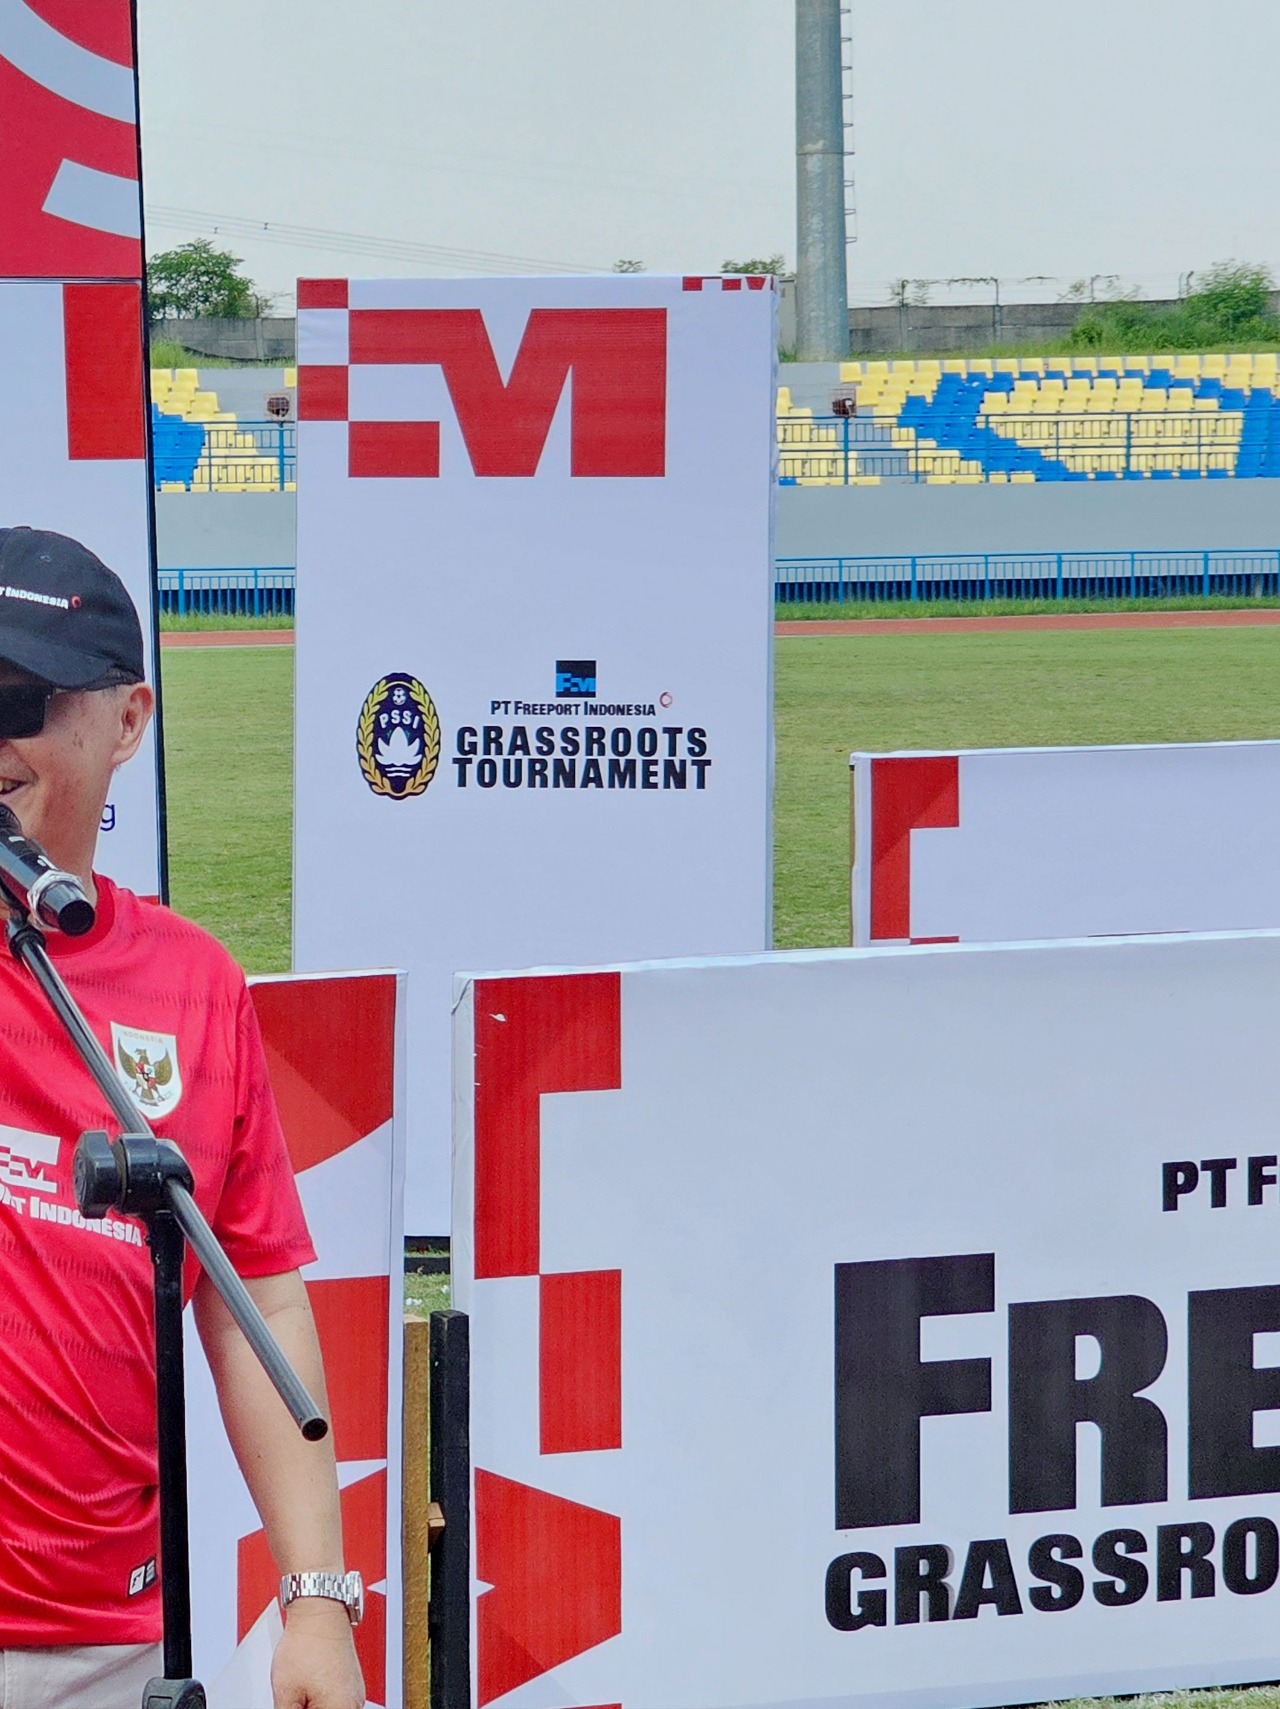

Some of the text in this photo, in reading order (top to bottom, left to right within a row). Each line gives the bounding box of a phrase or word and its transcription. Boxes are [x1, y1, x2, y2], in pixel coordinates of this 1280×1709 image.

[379, 709, 420, 729] PSSI
[491, 701, 657, 716] PT FREEPORT INDONESIA
[456, 726, 708, 757] GRASSROOTS
[452, 757, 712, 790] TOURNAMENT
[1162, 1158, 1237, 1212] PT
[30, 1196, 143, 1247] INDONESIA
